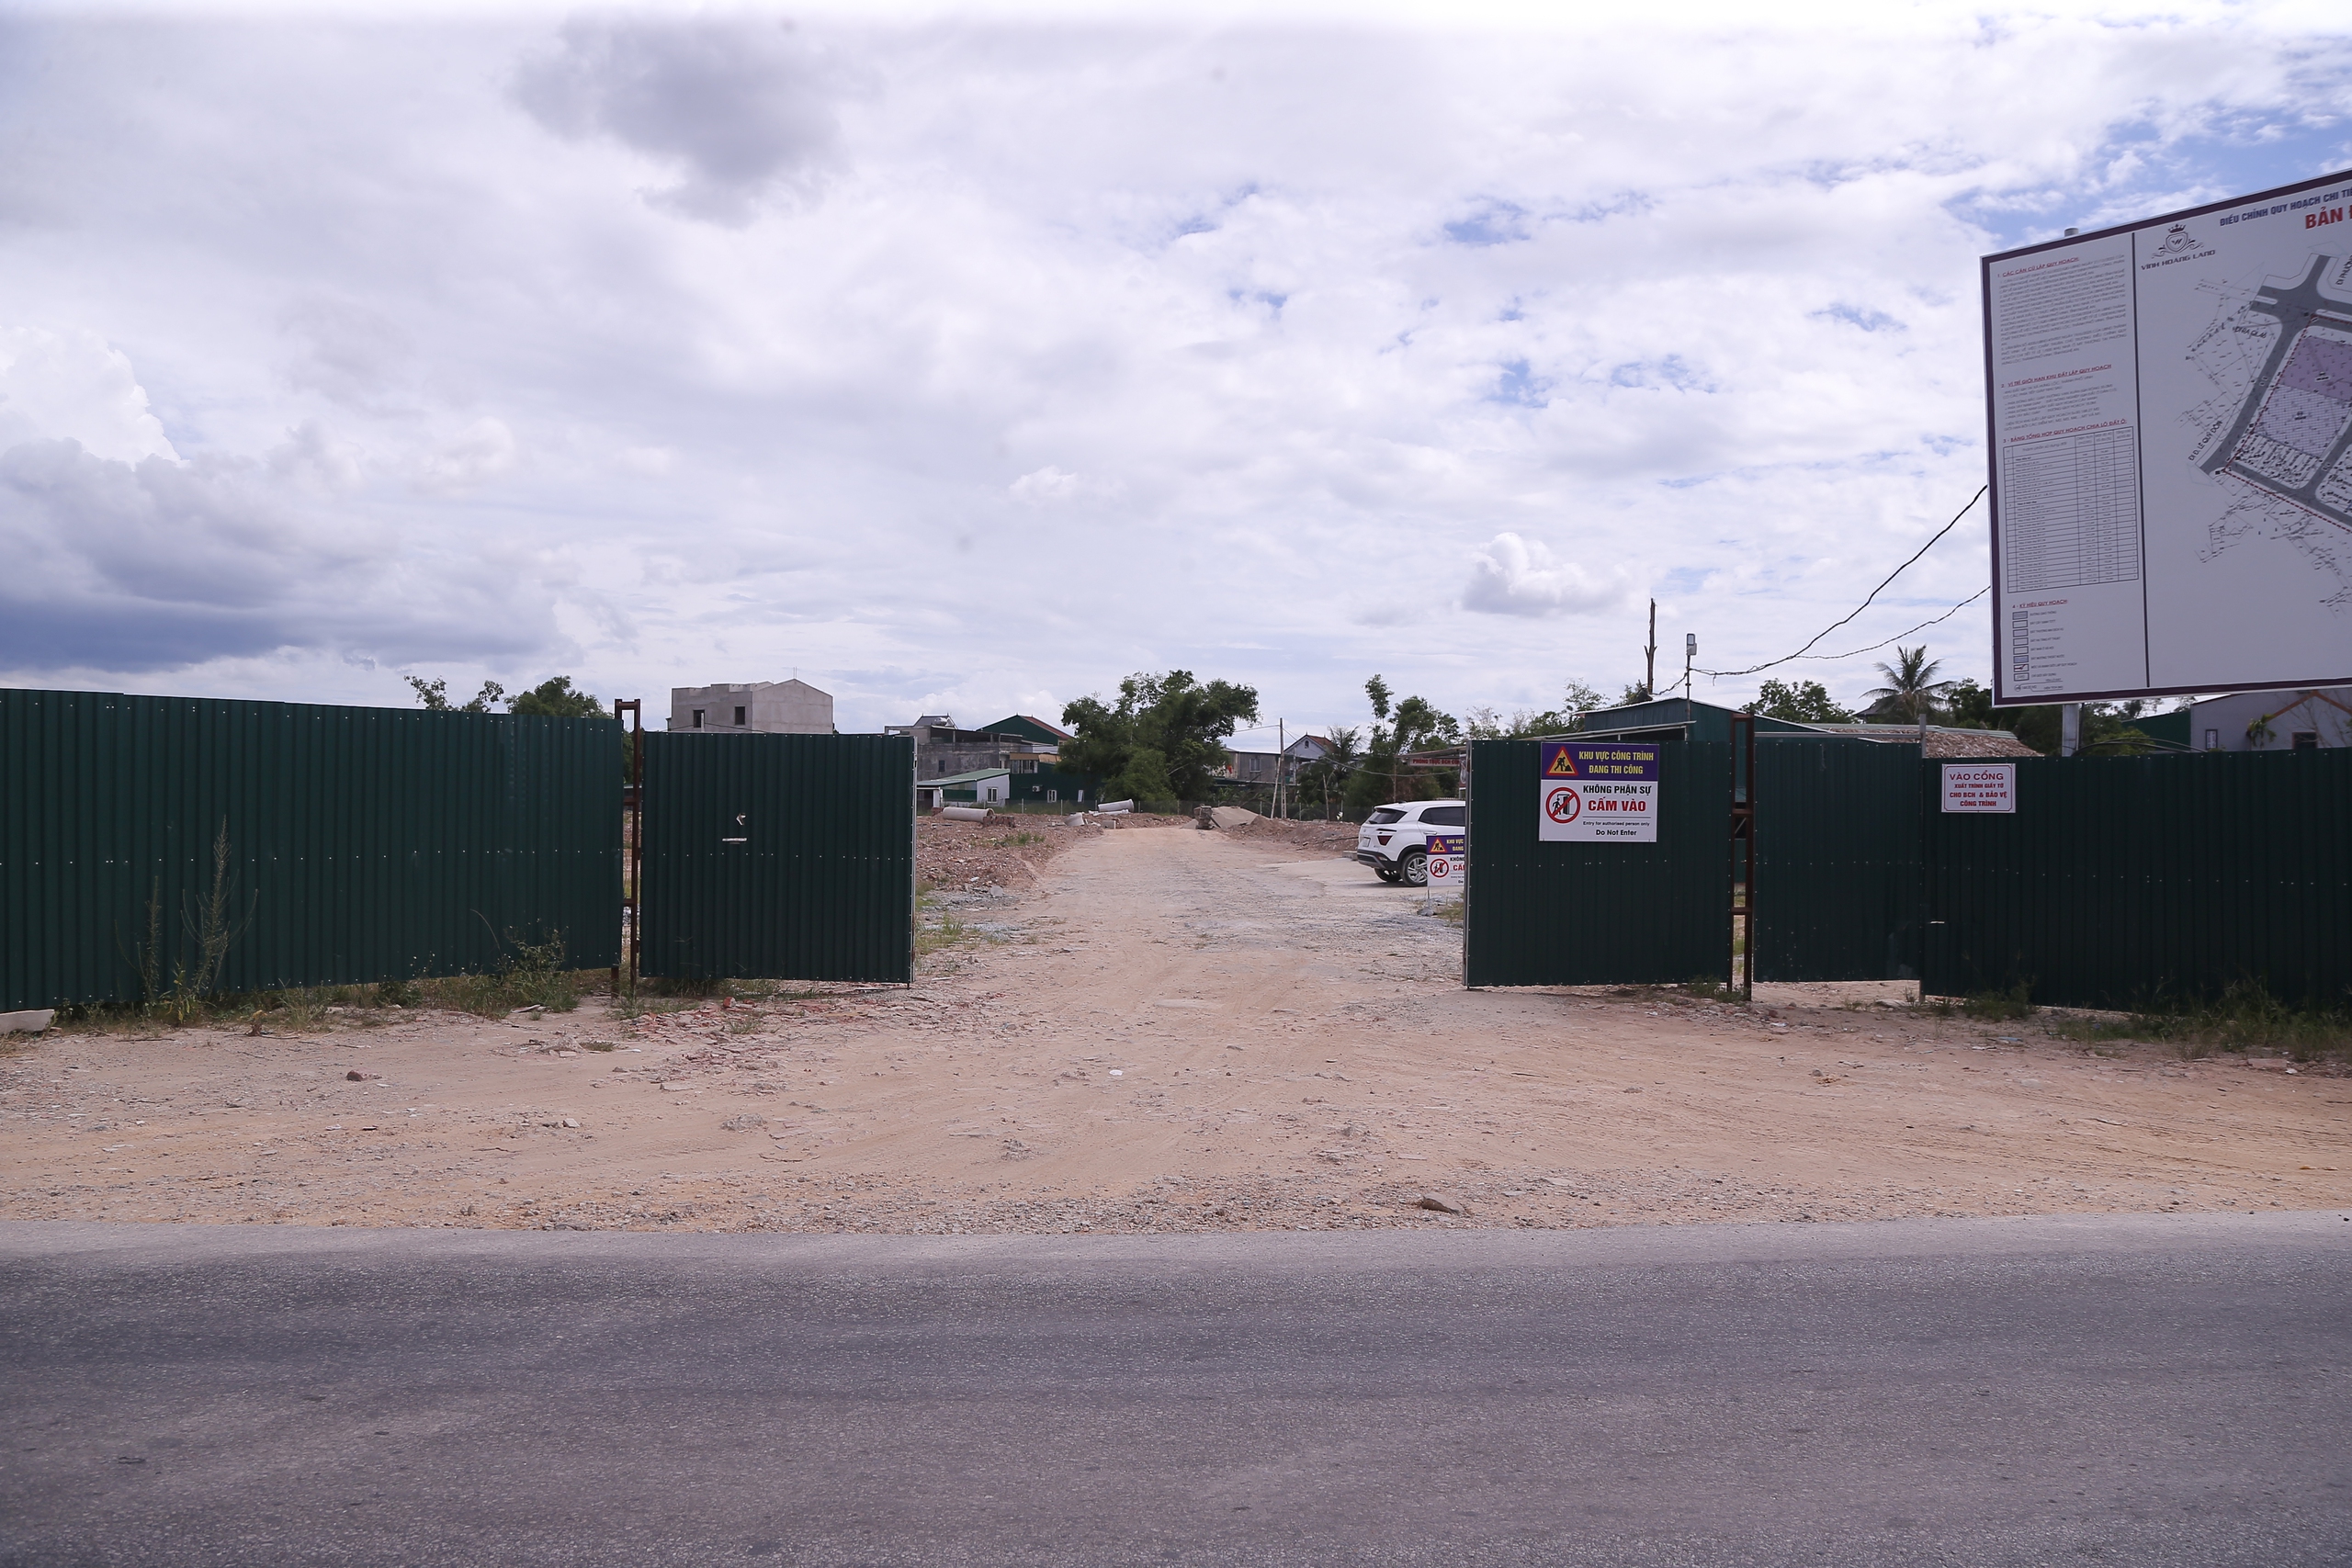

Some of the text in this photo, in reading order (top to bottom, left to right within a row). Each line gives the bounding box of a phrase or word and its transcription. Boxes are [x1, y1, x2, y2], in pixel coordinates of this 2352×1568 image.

[2271, 203, 2288, 214] QUY
[2290, 196, 2320, 210] HOẠCH
[2324, 192, 2338, 202] CHI
[2305, 206, 2343, 229] BẢN
[2193, 250, 2216, 259] LAND
[1595, 751, 1609, 761] VỰC
[1611, 750, 1631, 760] CÔNG
[1633, 751, 1653, 761] TRÌNH
[1589, 764, 1643, 774] ĐANG THI CÔNG
[1973, 770, 2004, 780] CỔNG
[1583, 784, 1652, 796] KHÔNG PHẬN SỰ
[1588, 796, 1646, 811] CẤM VÀO
